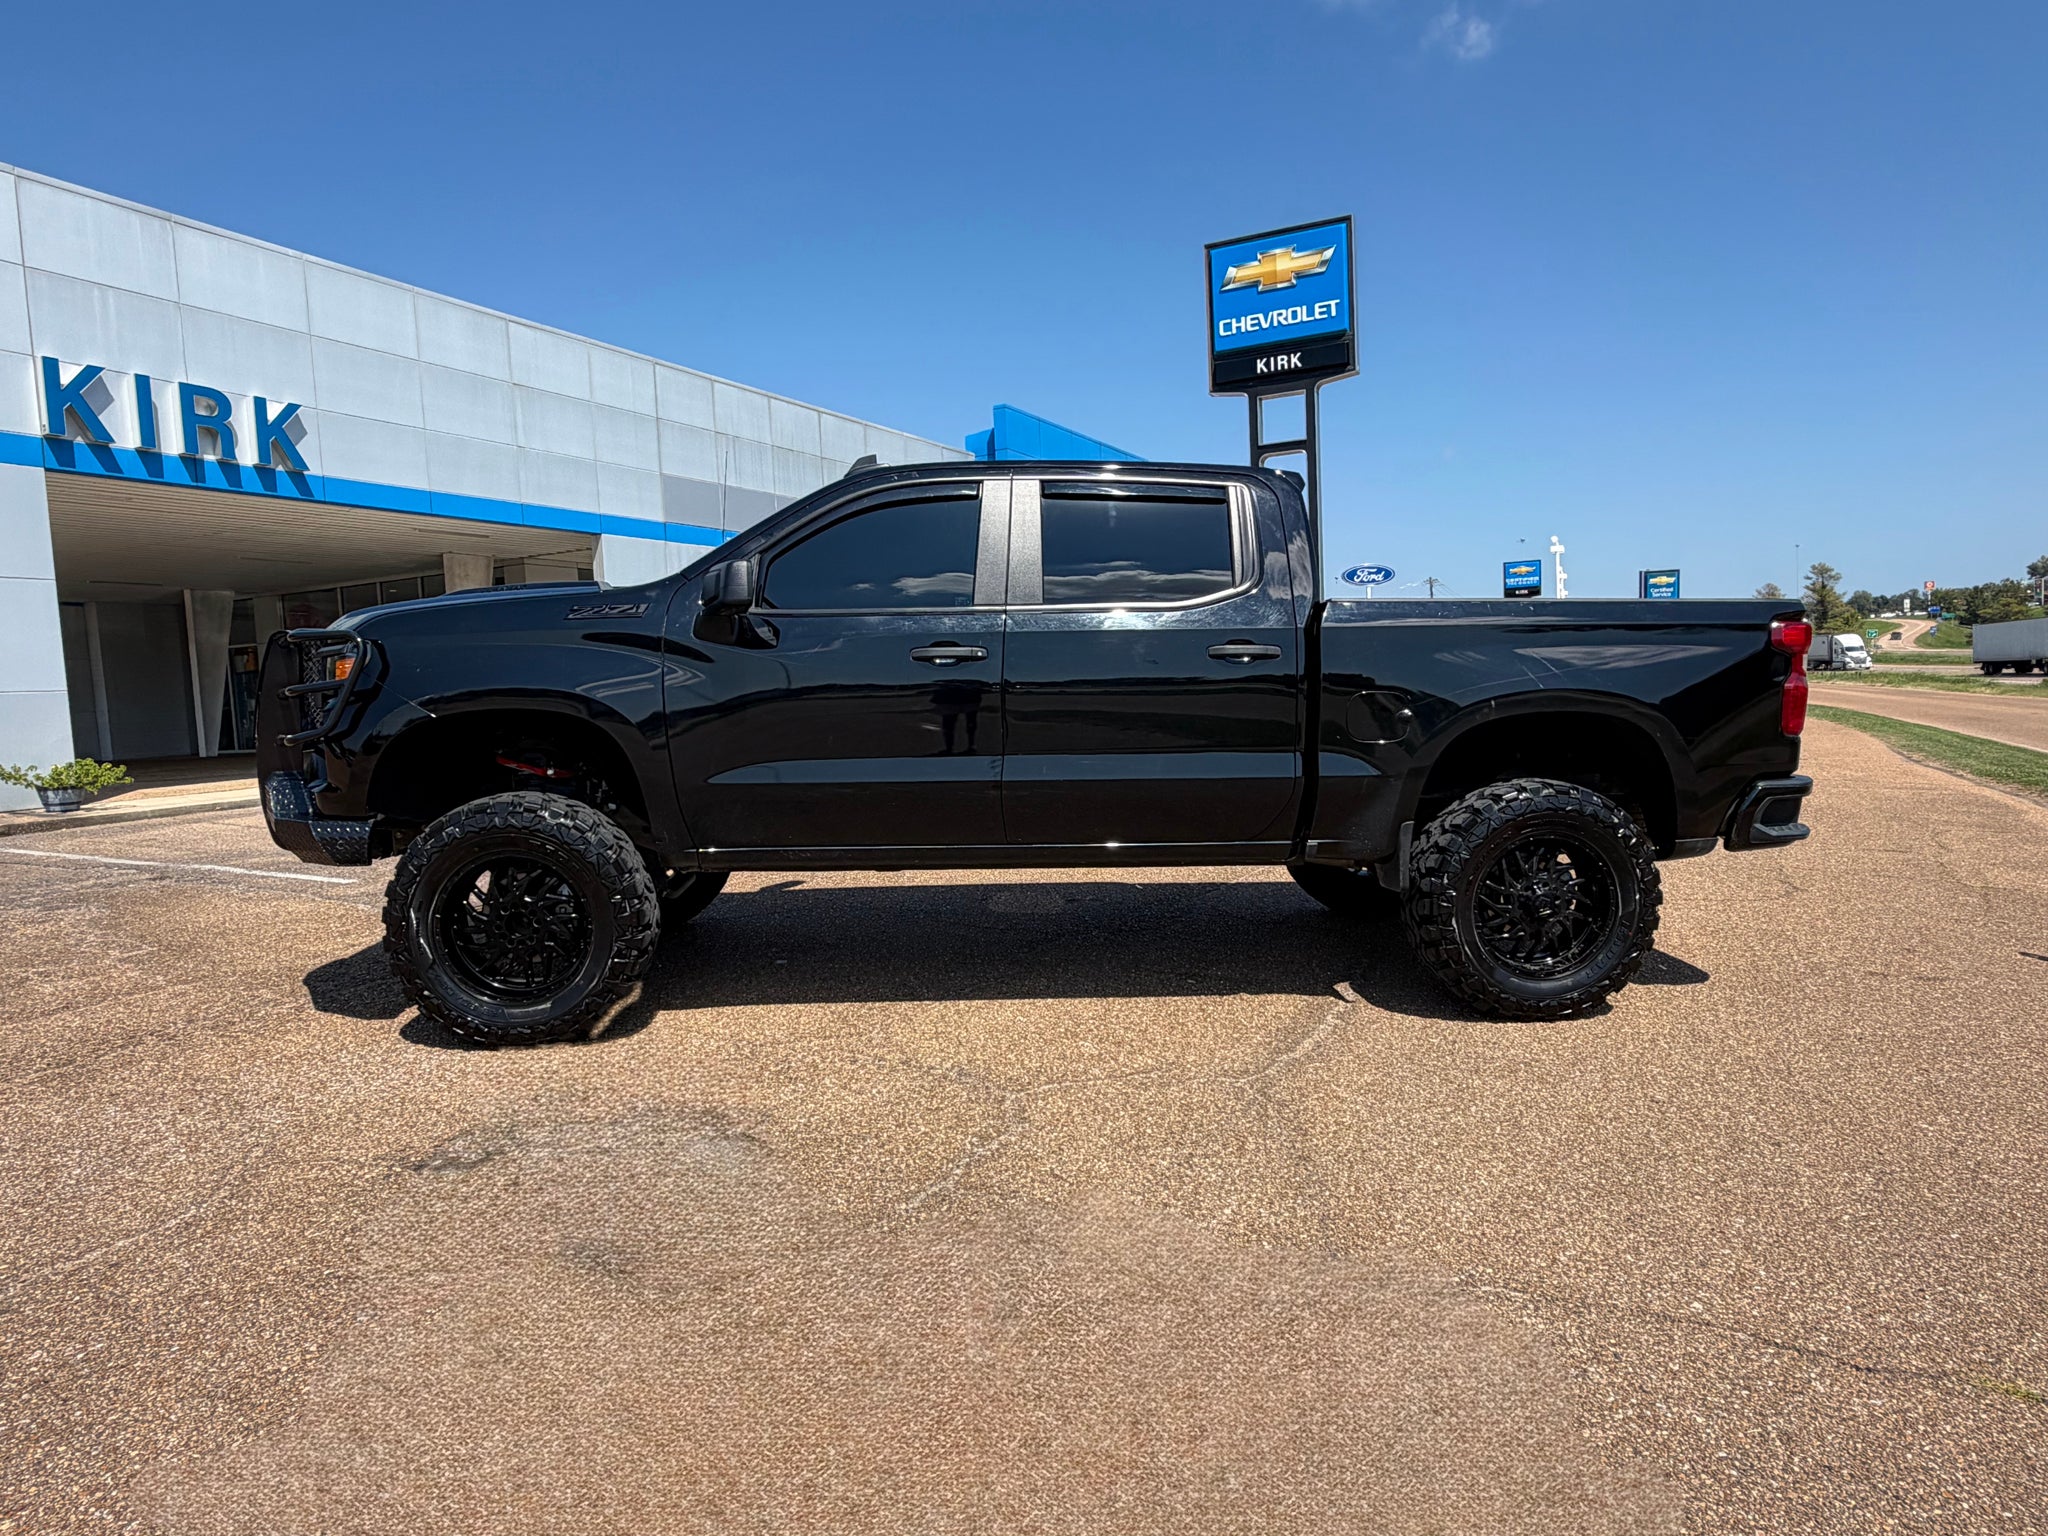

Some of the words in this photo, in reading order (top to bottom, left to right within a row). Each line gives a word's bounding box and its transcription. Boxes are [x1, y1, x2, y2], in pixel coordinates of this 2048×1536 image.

[1218, 299, 1341, 337] CHEVROLET
[1256, 352, 1303, 374] KIRK
[39, 355, 311, 472] KIRK
[1353, 568, 1386, 583] Ford
